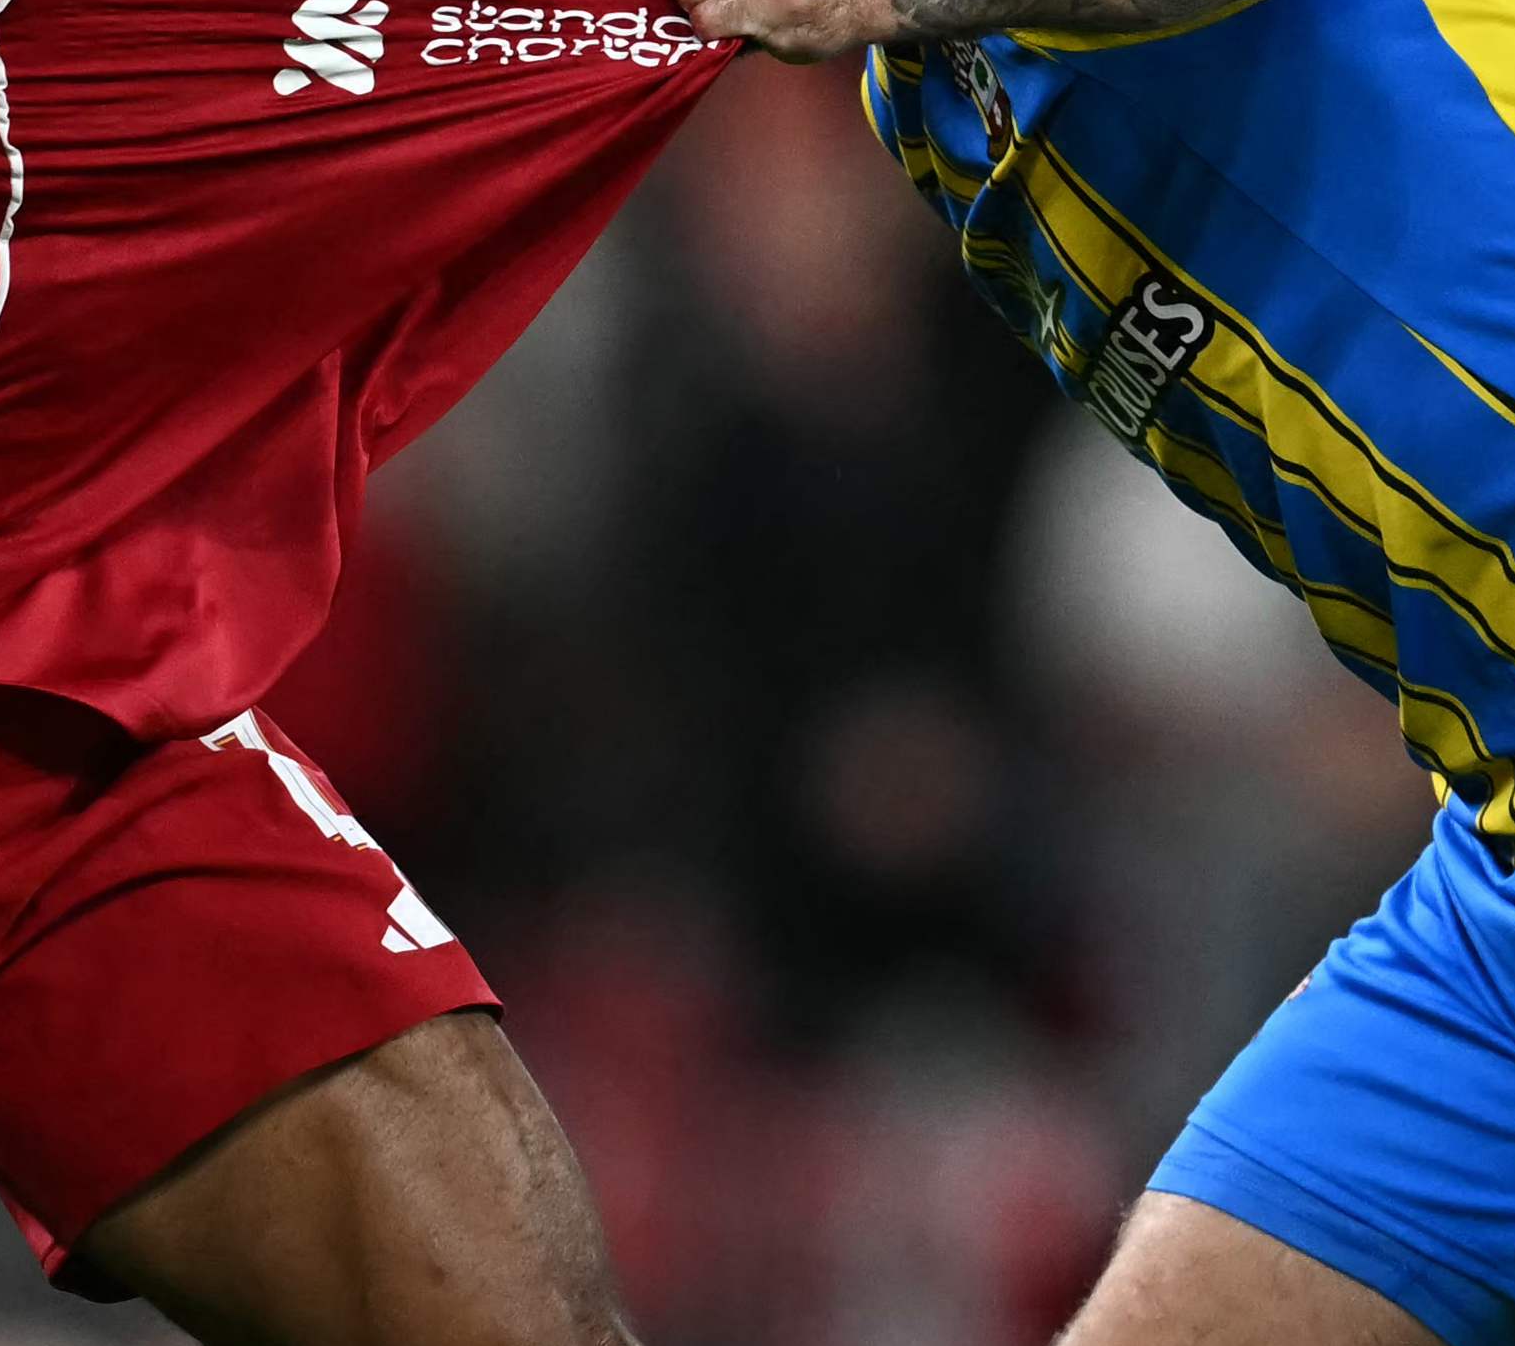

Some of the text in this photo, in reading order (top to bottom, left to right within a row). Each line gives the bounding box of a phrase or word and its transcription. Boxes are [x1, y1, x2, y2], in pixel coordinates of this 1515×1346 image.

[431, 0, 702, 43] standa
[420, 33, 720, 66] charter
[1087, 281, 1205, 438] CRUISES
